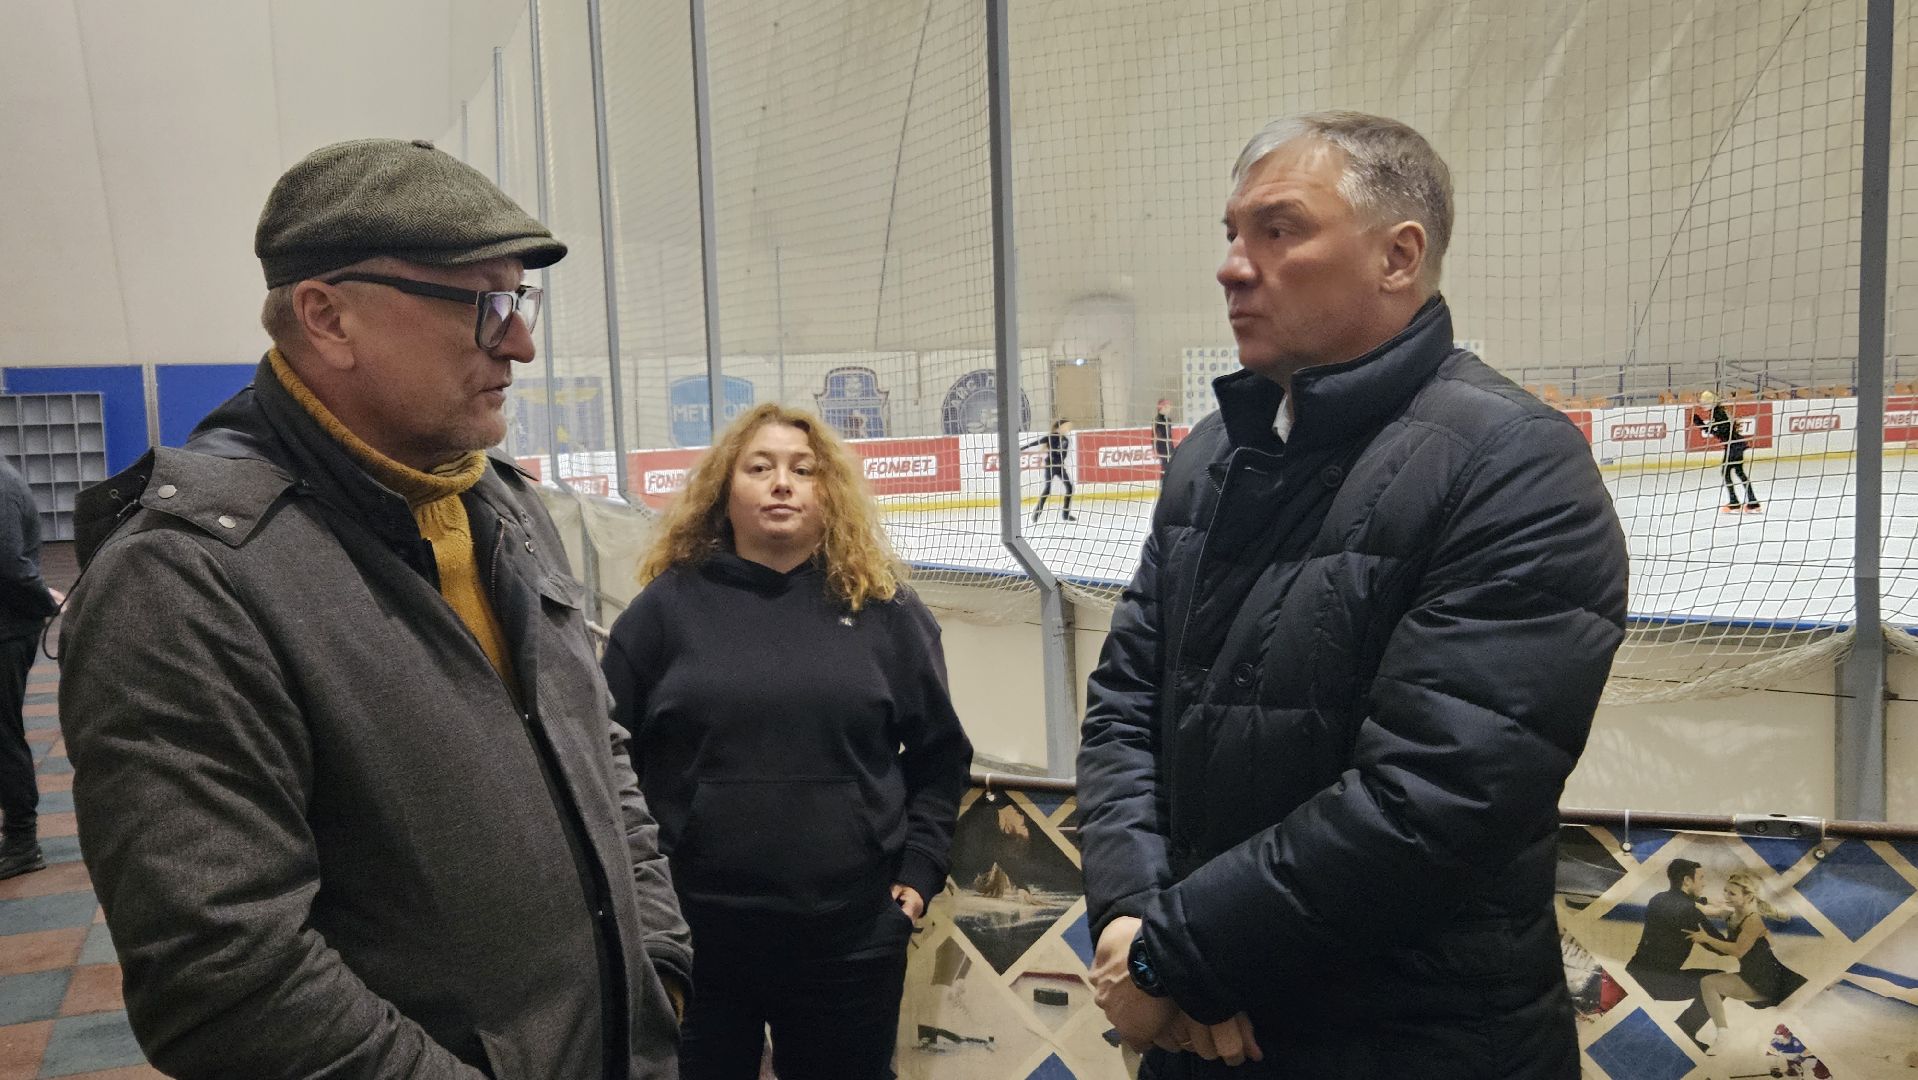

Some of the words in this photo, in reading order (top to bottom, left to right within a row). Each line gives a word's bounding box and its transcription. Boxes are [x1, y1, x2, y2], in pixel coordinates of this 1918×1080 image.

[1791, 416, 1838, 430] FONBET
[1883, 412, 1918, 426] ONBET
[1613, 425, 1663, 439] FONBET
[1102, 449, 1158, 463] FONBE
[866, 459, 932, 475] FONBET
